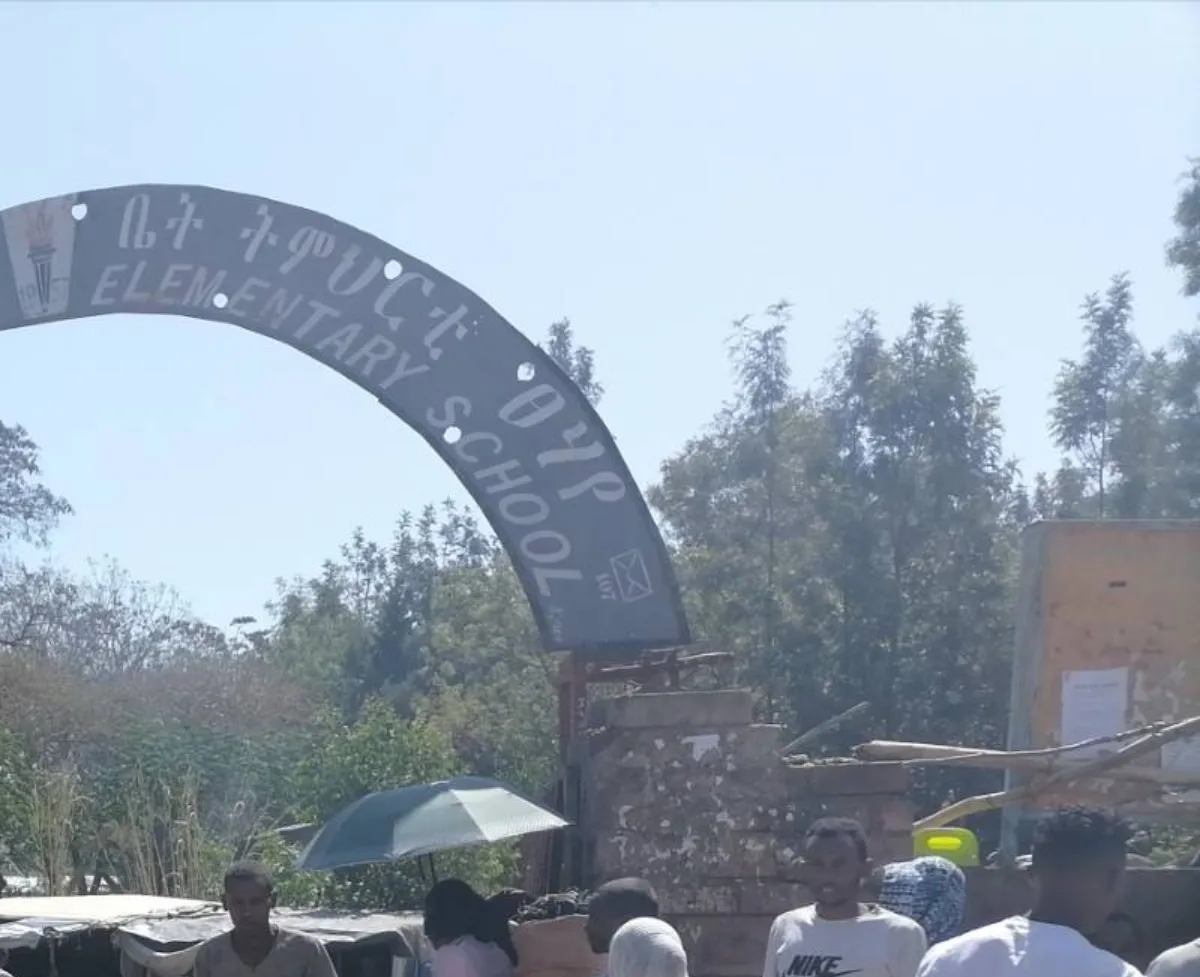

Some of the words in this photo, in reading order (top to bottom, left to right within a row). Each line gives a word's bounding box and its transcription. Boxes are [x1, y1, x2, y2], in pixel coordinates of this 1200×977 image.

[118, 192, 205, 250] ቤት
[240, 203, 469, 361] ትምህርቲ
[90, 260, 430, 390] ELEMENTARY
[426, 395, 583, 598] SCHOOL
[787, 954, 843, 977] NIKE
